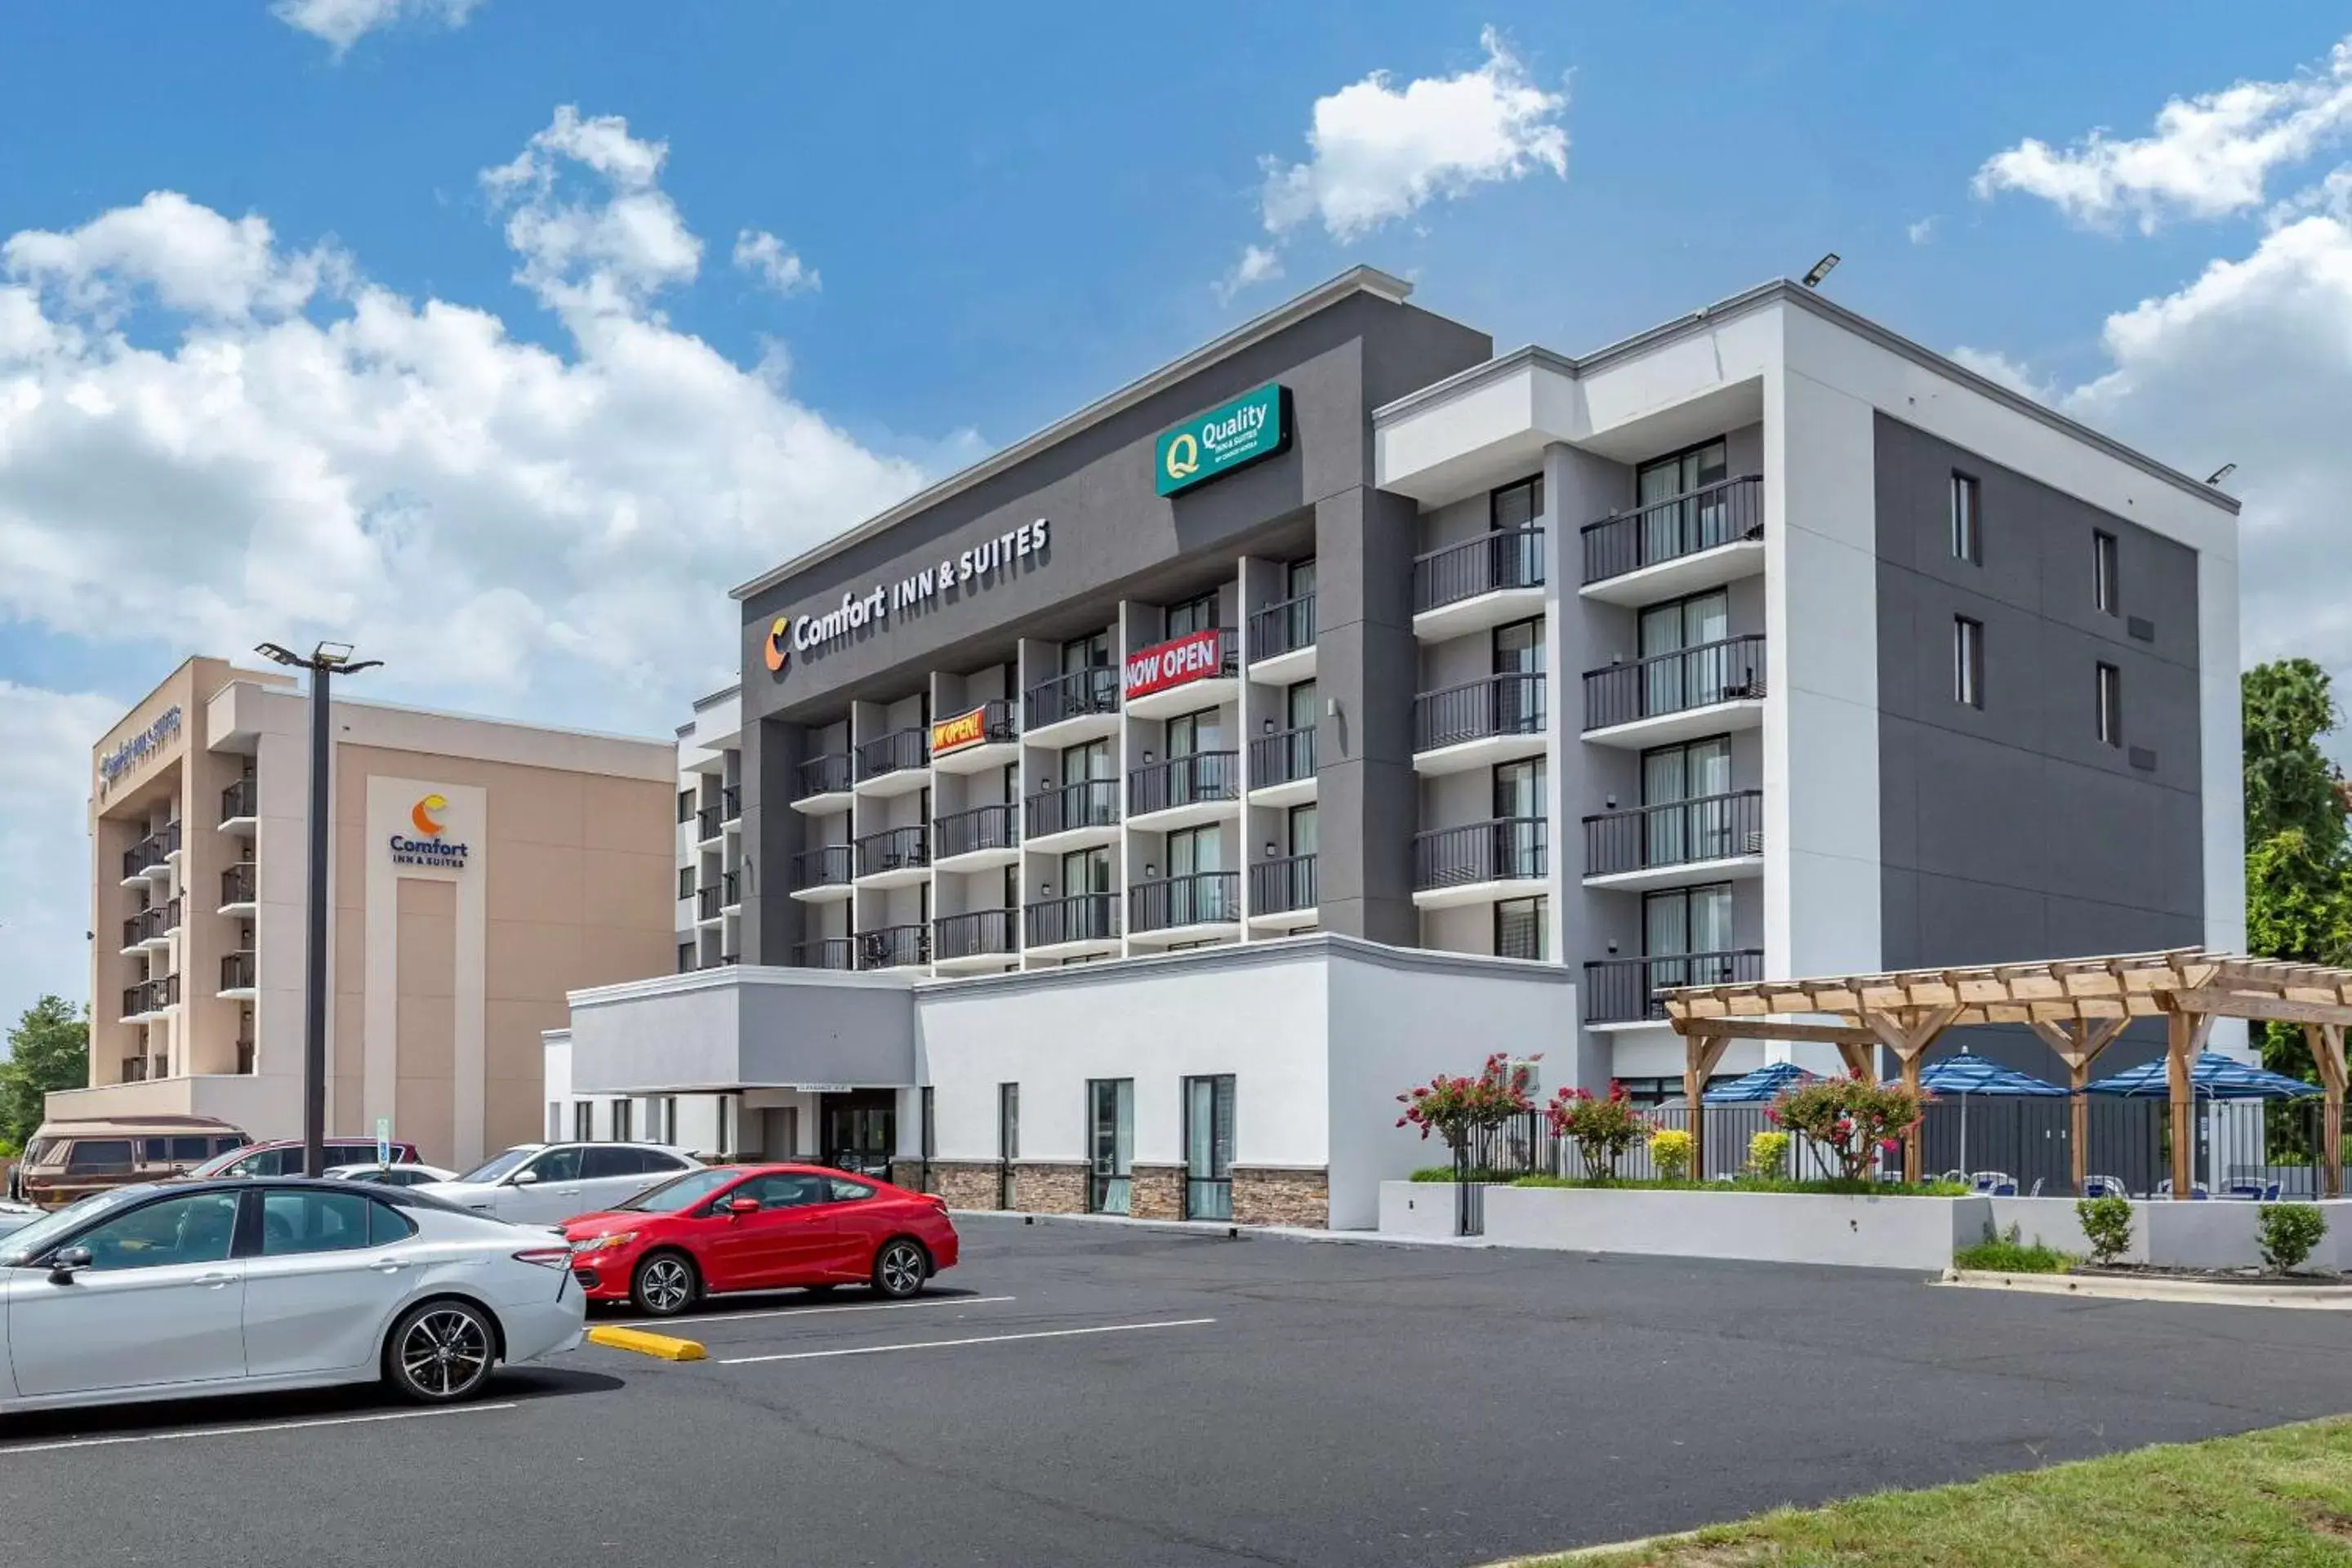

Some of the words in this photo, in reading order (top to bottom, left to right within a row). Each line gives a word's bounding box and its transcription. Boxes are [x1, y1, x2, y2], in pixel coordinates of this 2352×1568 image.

[1202, 403, 1267, 449] Quality
[1167, 434, 1200, 479] Q
[793, 585, 886, 651] Comfort
[893, 568, 933, 610] INN
[939, 561, 955, 590] &
[959, 519, 1048, 581] SUITES
[1164, 639, 1214, 677] OPEN
[945, 713, 979, 744] OPEN!
[390, 835, 468, 857] Comfort
[393, 854, 413, 864] INN
[426, 858, 465, 868] SUITES
